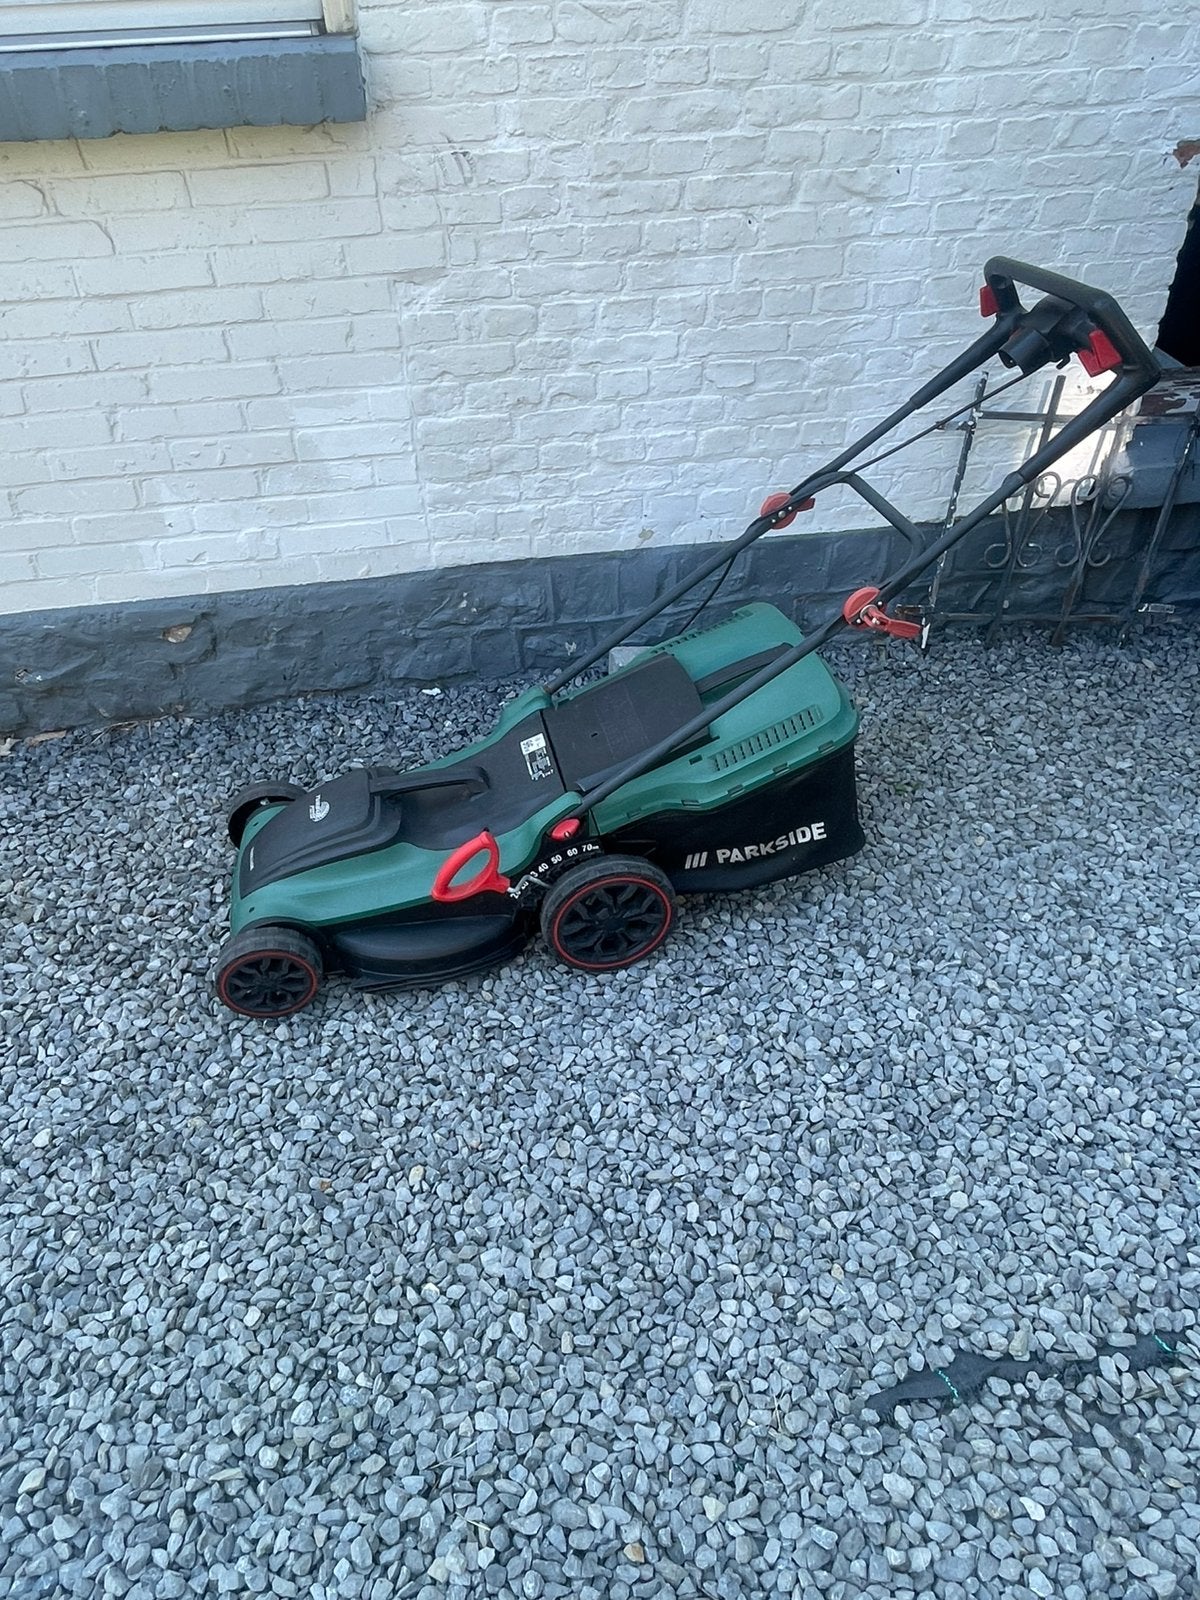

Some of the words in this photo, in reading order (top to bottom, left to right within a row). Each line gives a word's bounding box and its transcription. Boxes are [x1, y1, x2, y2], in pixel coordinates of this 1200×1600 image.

[716, 821, 827, 864] PARKSIDE
[538, 862, 549, 873] 40
[551, 854, 562, 864] 50
[567, 848, 578, 857] 60
